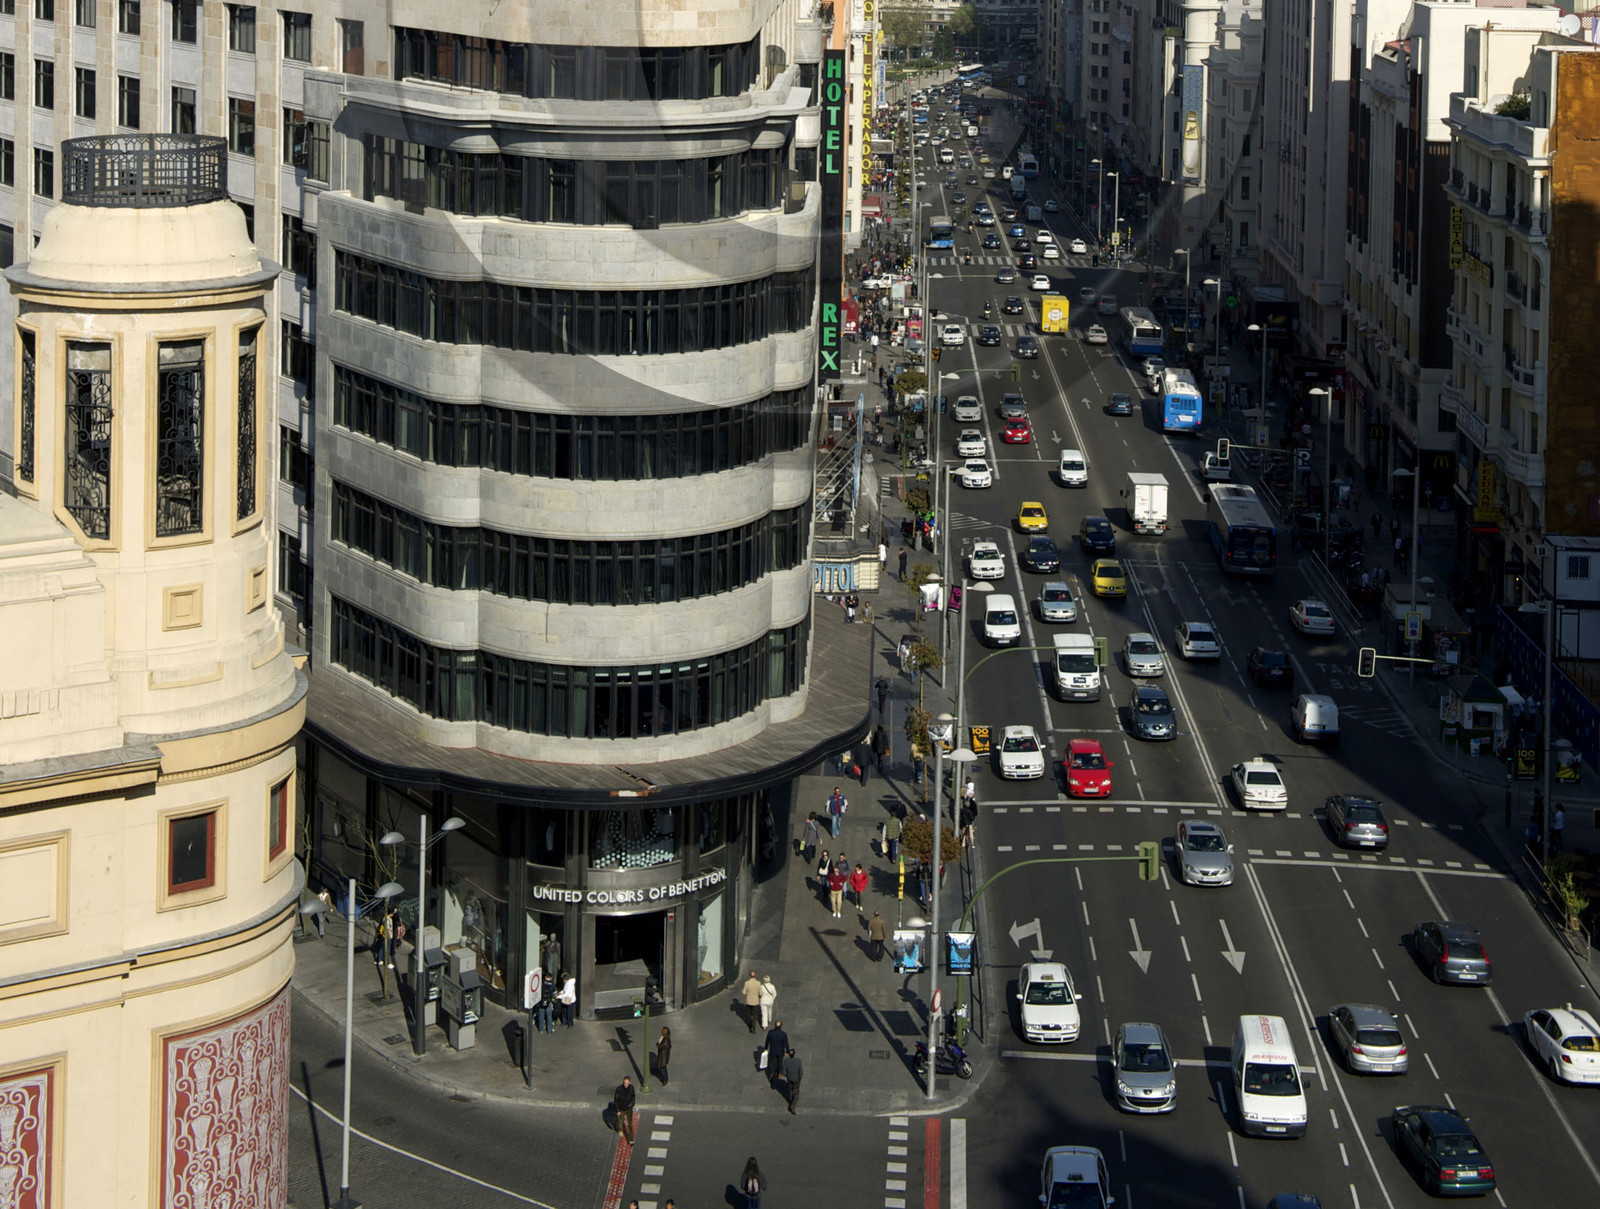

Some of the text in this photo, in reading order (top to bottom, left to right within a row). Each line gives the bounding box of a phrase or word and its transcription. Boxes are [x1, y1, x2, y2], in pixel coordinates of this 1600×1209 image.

[862, 63, 873, 184] EMPERADOR
[821, 58, 842, 371] HOTEL REX
[1451, 208, 1463, 254] HOSTAL
[814, 561, 859, 591] PITOL
[1315, 662, 1358, 676] TAX
[1329, 678, 1374, 692] BUS
[1517, 749, 1535, 757] 100
[533, 886, 582, 903] UNITED
[587, 889, 644, 904] COLORS
[649, 887, 667, 900] OF
